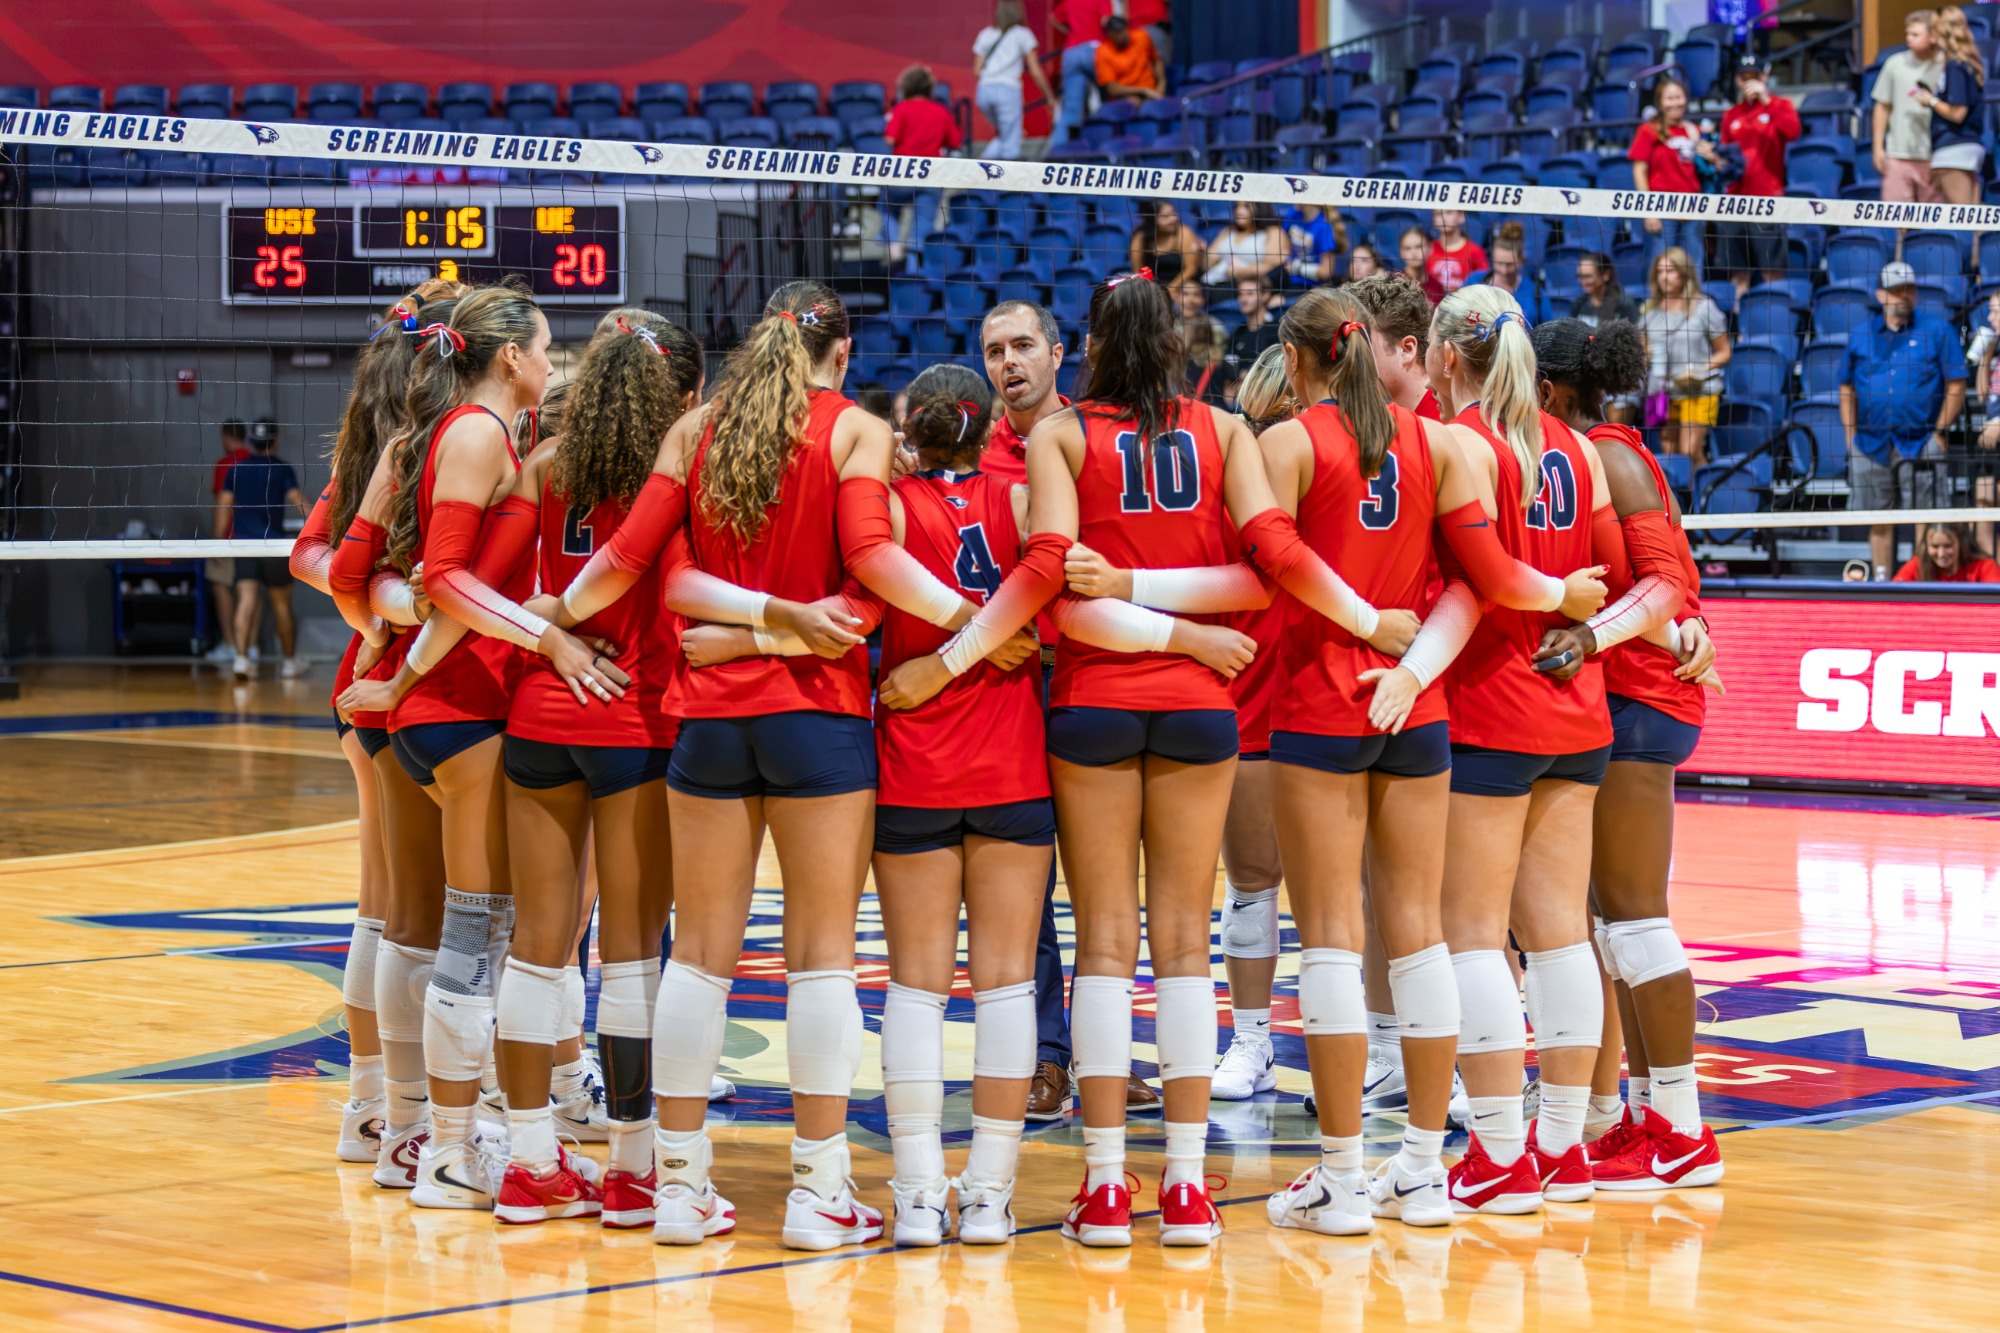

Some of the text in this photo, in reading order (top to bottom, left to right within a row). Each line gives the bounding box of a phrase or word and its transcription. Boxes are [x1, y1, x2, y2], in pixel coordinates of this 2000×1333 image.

[85, 114, 187, 143] EAGLES
[327, 128, 583, 163] SCREAMING EAGLES
[706, 148, 932, 179] SCREAMING EAGLES
[1042, 165, 1244, 194] SCREAMING EAGLES
[1342, 179, 1524, 206] SCREAMING EAGLES
[1612, 192, 1776, 216] SCREAMING EAGLES
[265, 208, 316, 235] USI
[405, 207, 483, 249] 1:15
[536, 207, 575, 234] UE
[1853, 202, 2000, 225] SCREAMING EAGLES
[254, 246, 307, 288] 25
[553, 244, 606, 287] 20
[1115, 429, 1201, 513] 10
[1358, 449, 1400, 531] 3
[953, 521, 1003, 606] 4
[1796, 648, 2000, 738] SCR
